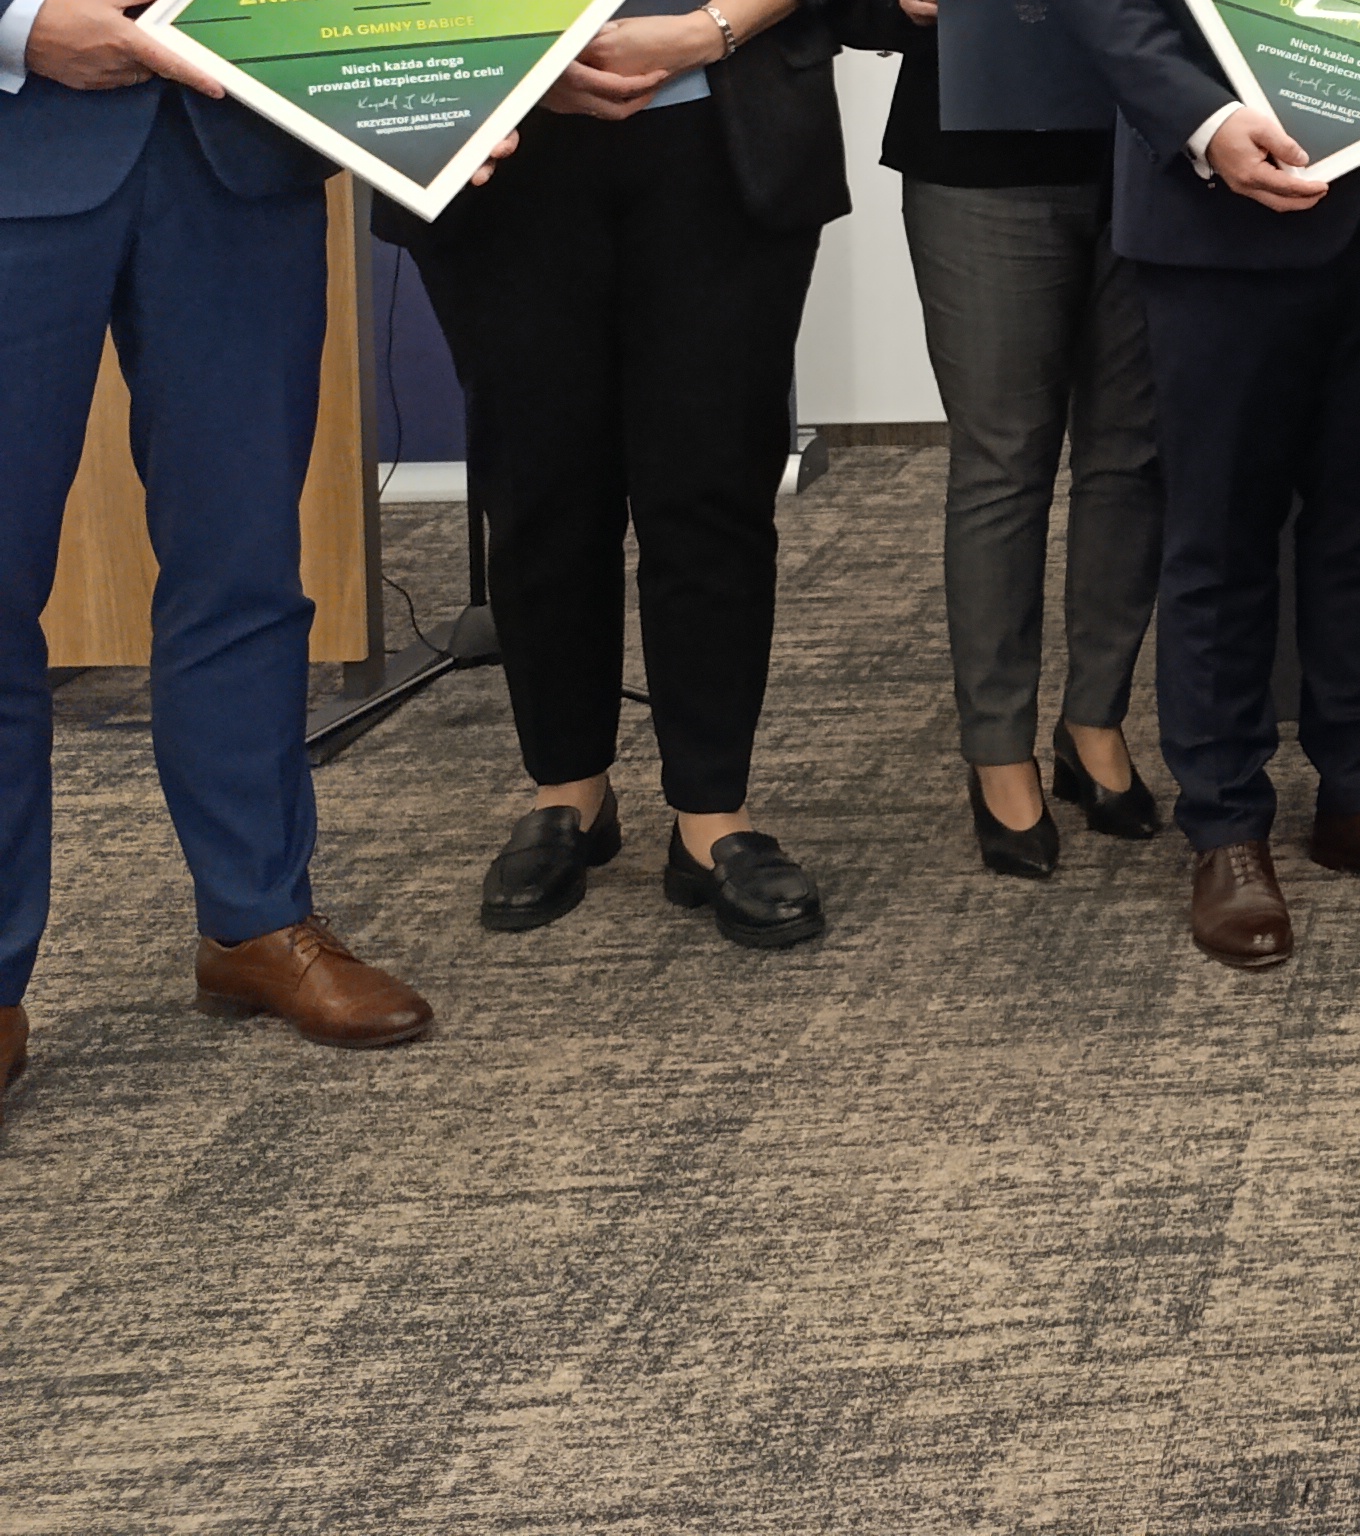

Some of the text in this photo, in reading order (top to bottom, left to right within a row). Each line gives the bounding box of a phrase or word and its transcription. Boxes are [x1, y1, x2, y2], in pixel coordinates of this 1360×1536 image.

[320, 15, 475, 39] DLA GMINY BABICE
[1257, 42, 1307, 65] prowadzi
[1290, 38, 1321, 54] Niech
[1323, 48, 1355, 64] każda
[341, 56, 464, 76] Niech każda droga
[308, 66, 504, 96] prowadzi bezpiecznie do celu!
[1280, 89, 1322, 106] KRZYSZTOF
[1322, 102, 1337, 112] JAN
[356, 116, 410, 129] KRZYSZTOF
[410, 114, 429, 124] JAN
